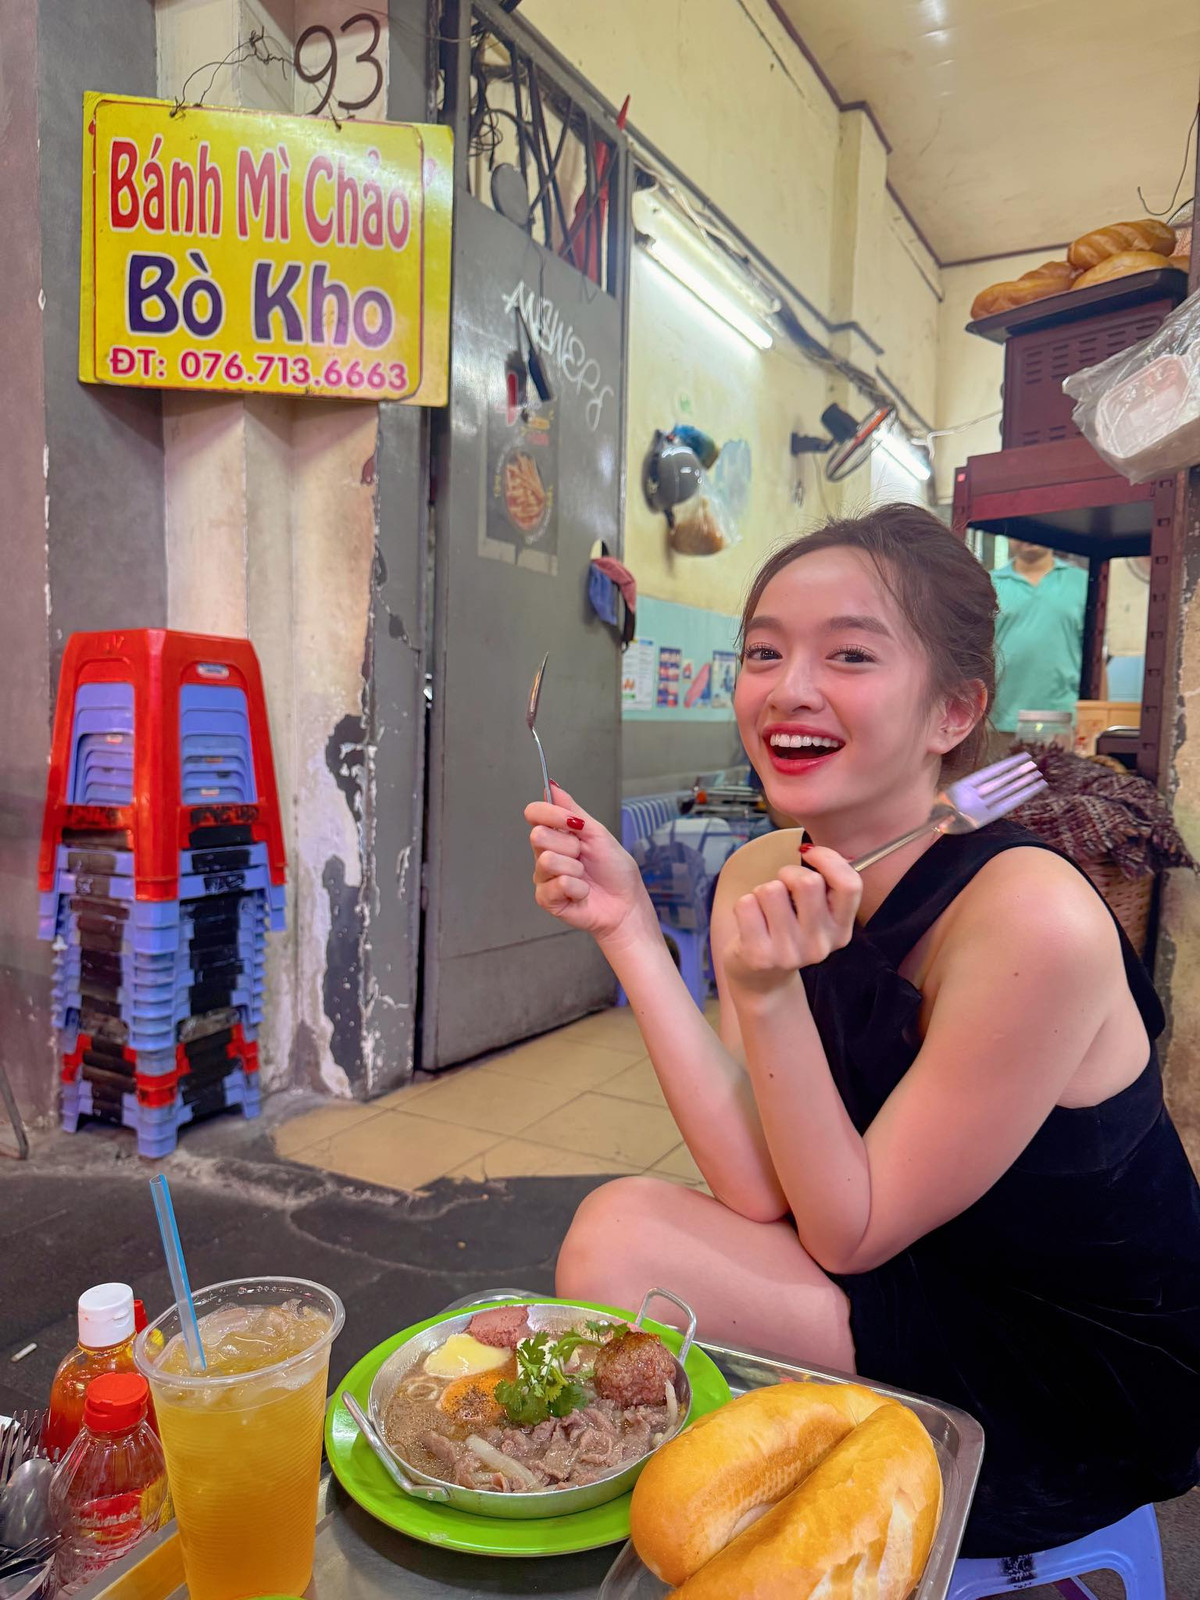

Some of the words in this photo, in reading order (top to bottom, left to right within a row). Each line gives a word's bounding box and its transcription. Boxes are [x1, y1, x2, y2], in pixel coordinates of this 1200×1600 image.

[294, 13, 383, 115] 93
[109, 134, 222, 238] Bánh
[237, 145, 291, 240] Mì
[304, 149, 411, 250] Chảo
[128, 252, 223, 337] Bò
[253, 262, 393, 349] Kho
[109, 347, 165, 378] ĐT:
[180, 351, 408, 391] 076.713.6663
